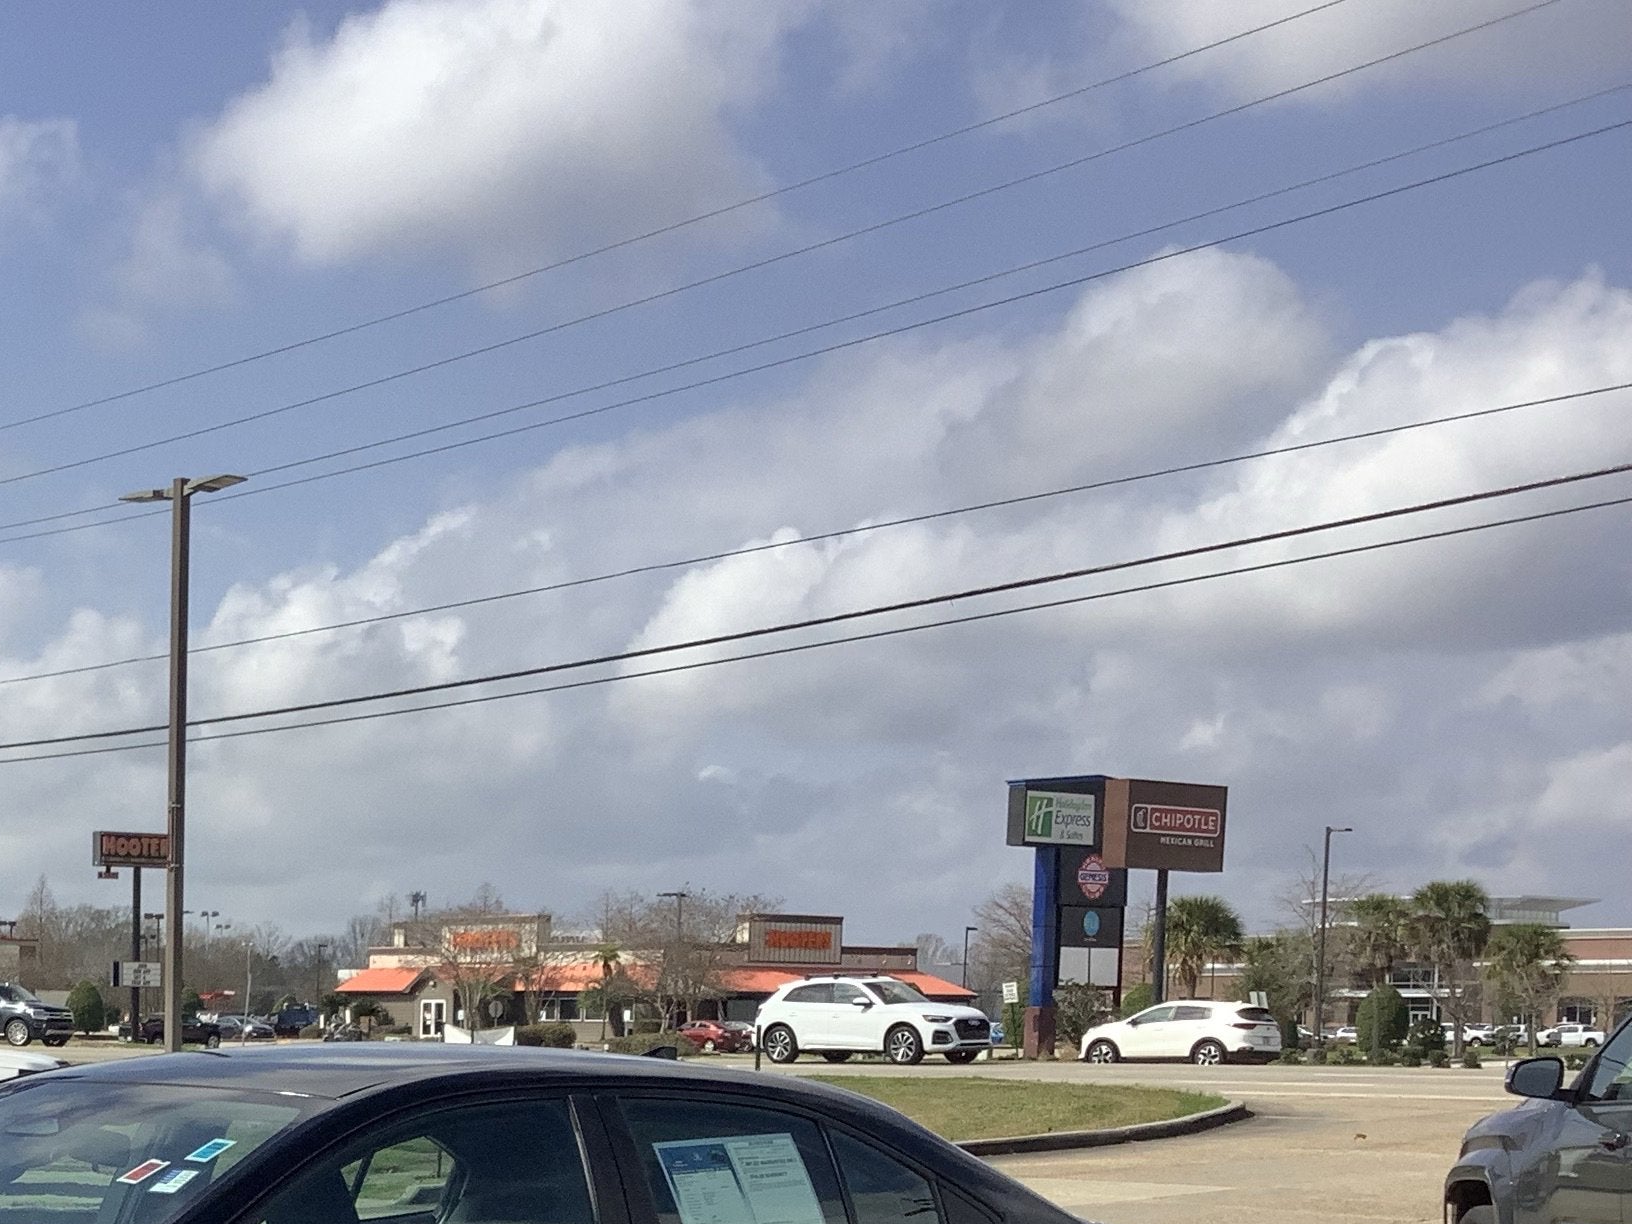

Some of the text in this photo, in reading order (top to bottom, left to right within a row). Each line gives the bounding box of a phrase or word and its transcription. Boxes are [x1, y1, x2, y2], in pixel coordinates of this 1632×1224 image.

[1054, 810, 1091, 828] Express
[1151, 812, 1217, 831] CHIPOTLE
[102, 835, 169, 857] HOOTE
[1160, 837, 1215, 848] MEXICAN GRILL
[1079, 872, 1107, 882] GENESIS
